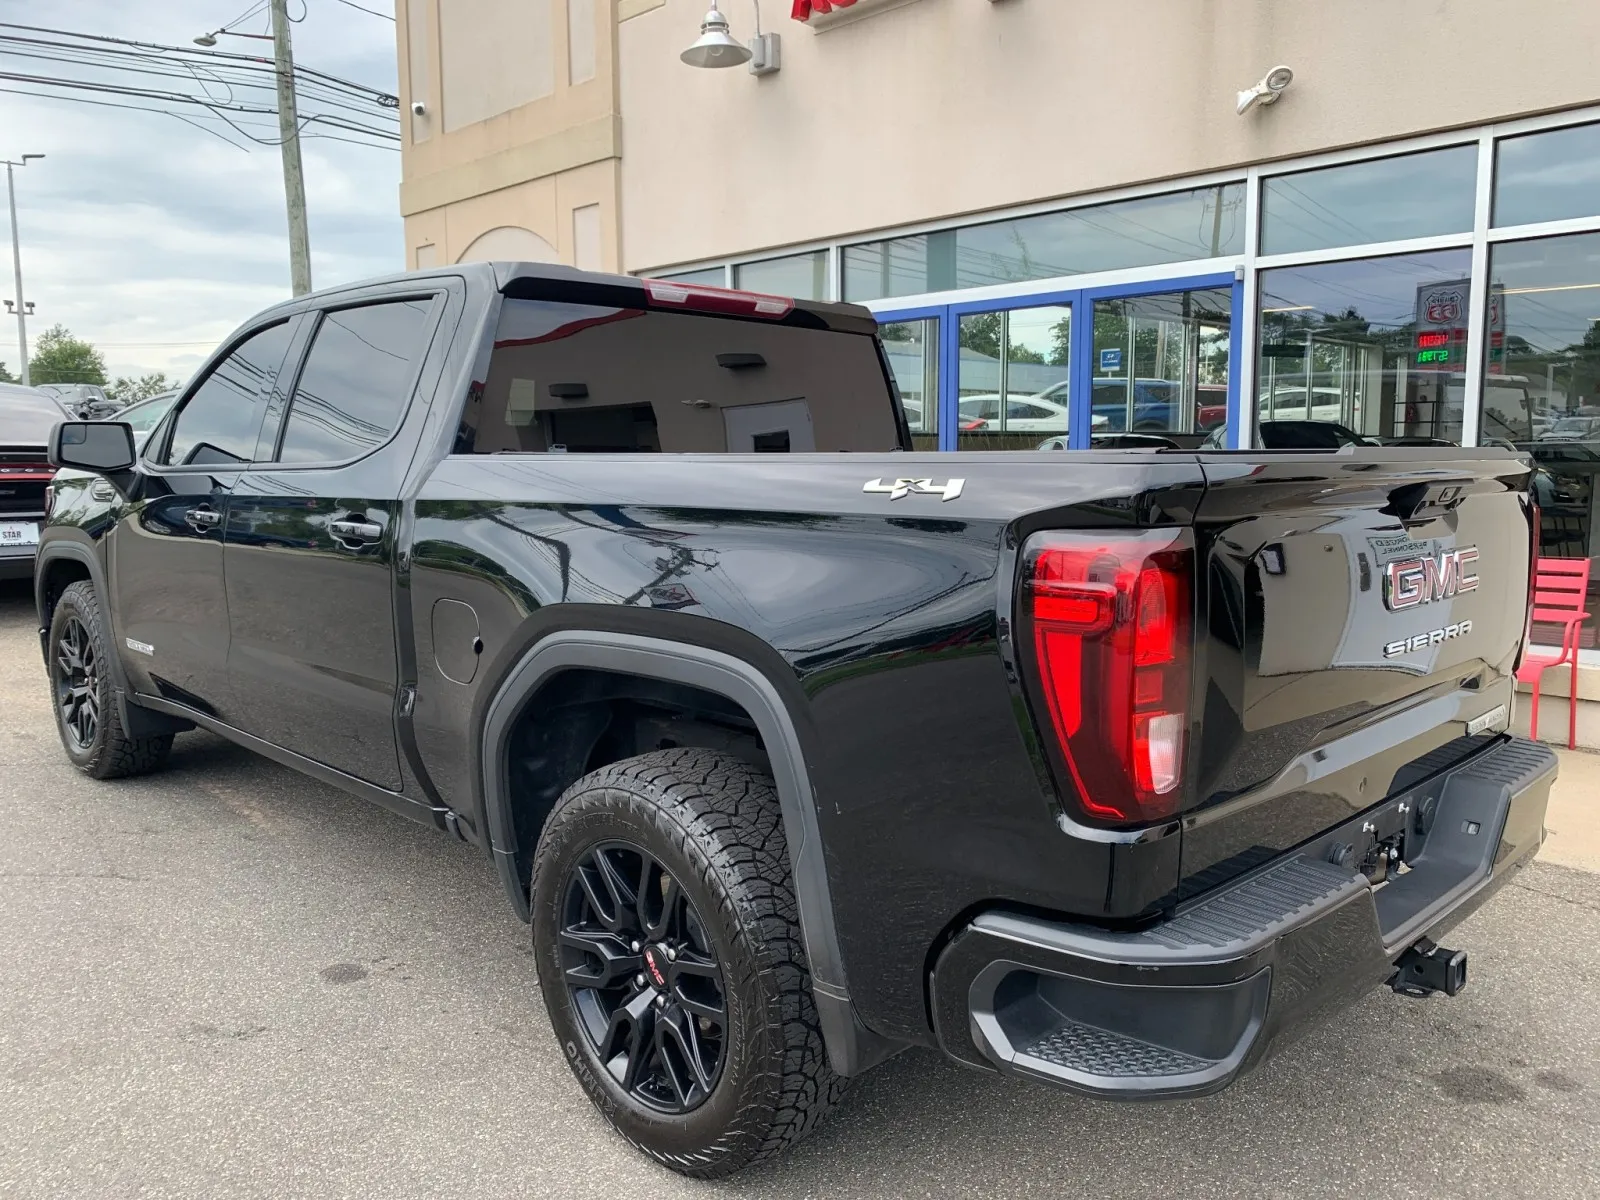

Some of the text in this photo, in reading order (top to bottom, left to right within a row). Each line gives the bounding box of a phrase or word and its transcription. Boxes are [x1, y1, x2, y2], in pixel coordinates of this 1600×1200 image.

[2, 531, 22, 539] STAR
[1385, 548, 1480, 611] GMC
[1384, 619, 1473, 658] SIERRA
[643, 950, 665, 986] GMC
[566, 1040, 618, 1118] KUMHO
